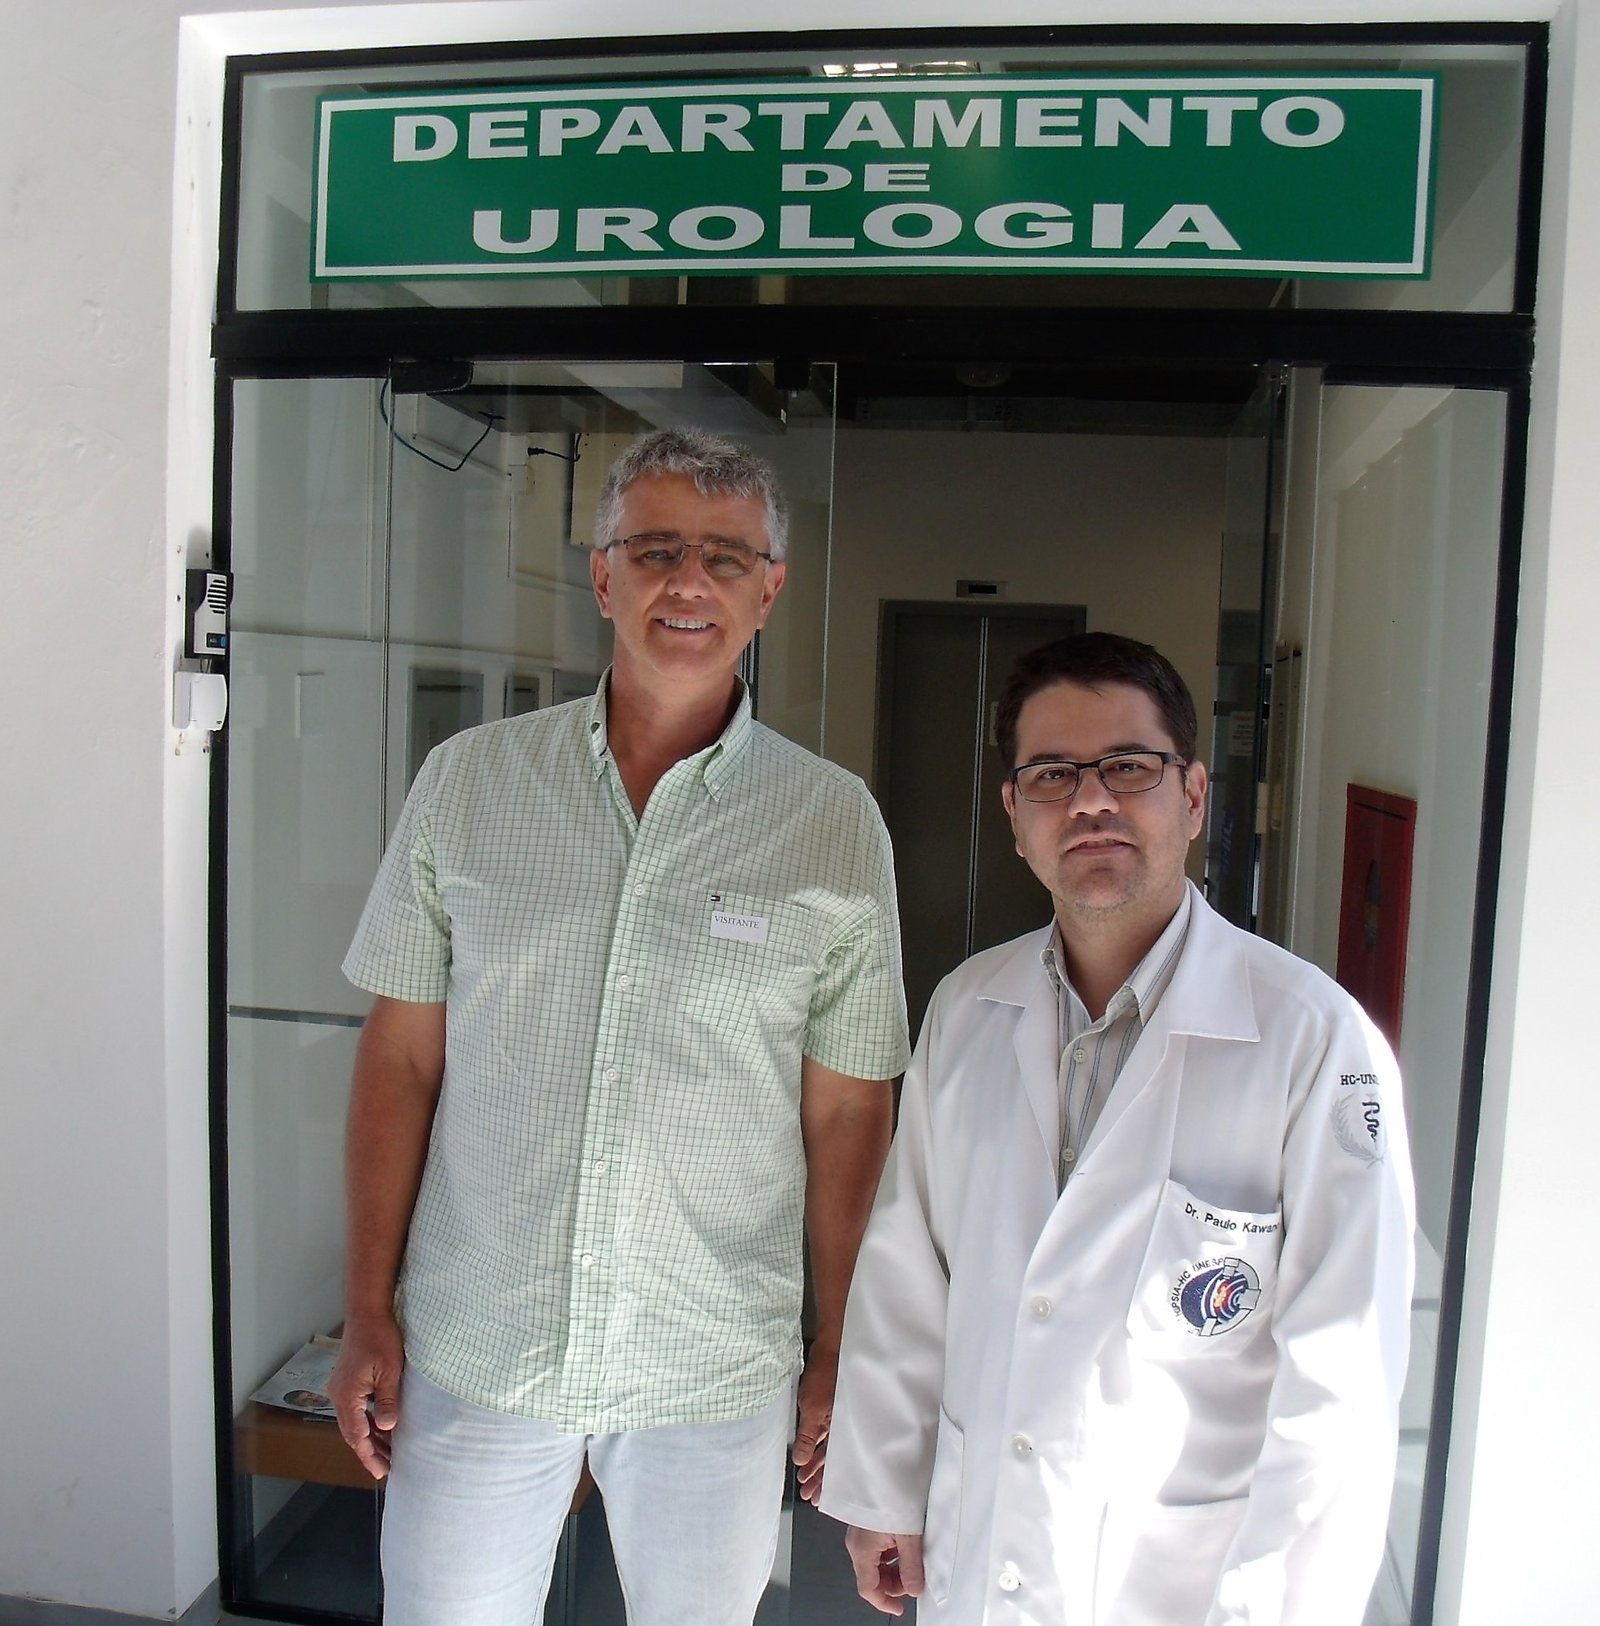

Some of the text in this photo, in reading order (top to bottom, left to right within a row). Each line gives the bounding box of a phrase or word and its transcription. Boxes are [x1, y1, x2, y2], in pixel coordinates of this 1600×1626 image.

[393, 96, 1345, 163] DEPARTAMENTO
[781, 163, 931, 192] DE
[472, 202, 1242, 254] UROLOGIA
[714, 915, 760, 929] VISITANTE
[1340, 1074, 1380, 1086] HC-UN
[1185, 1202, 1280, 1234] Dr. Paulo Kawan
